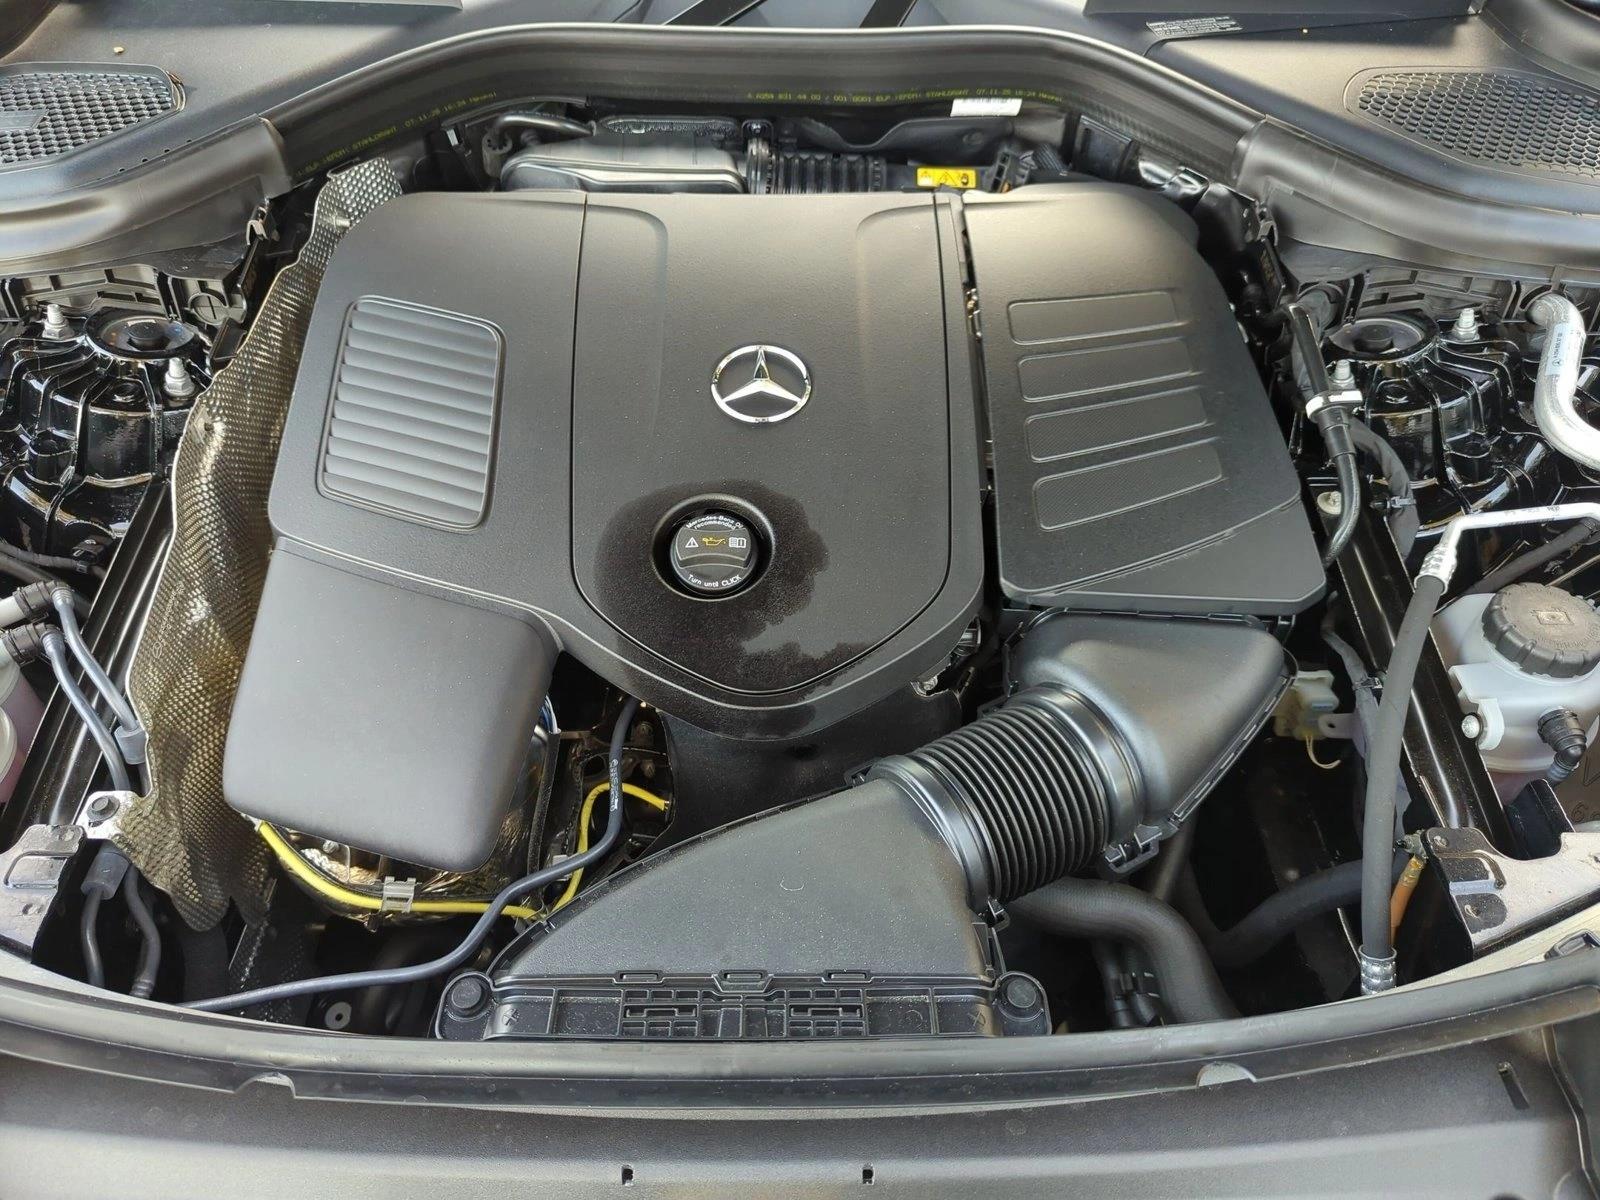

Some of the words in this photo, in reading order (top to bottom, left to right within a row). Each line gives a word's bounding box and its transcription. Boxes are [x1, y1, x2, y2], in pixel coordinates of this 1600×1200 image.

[686, 515, 735, 529] Mercedes-Benz
[694, 520, 736, 530] recommended
[688, 574, 702, 585] Turn
[721, 574, 742, 587] CLICK
